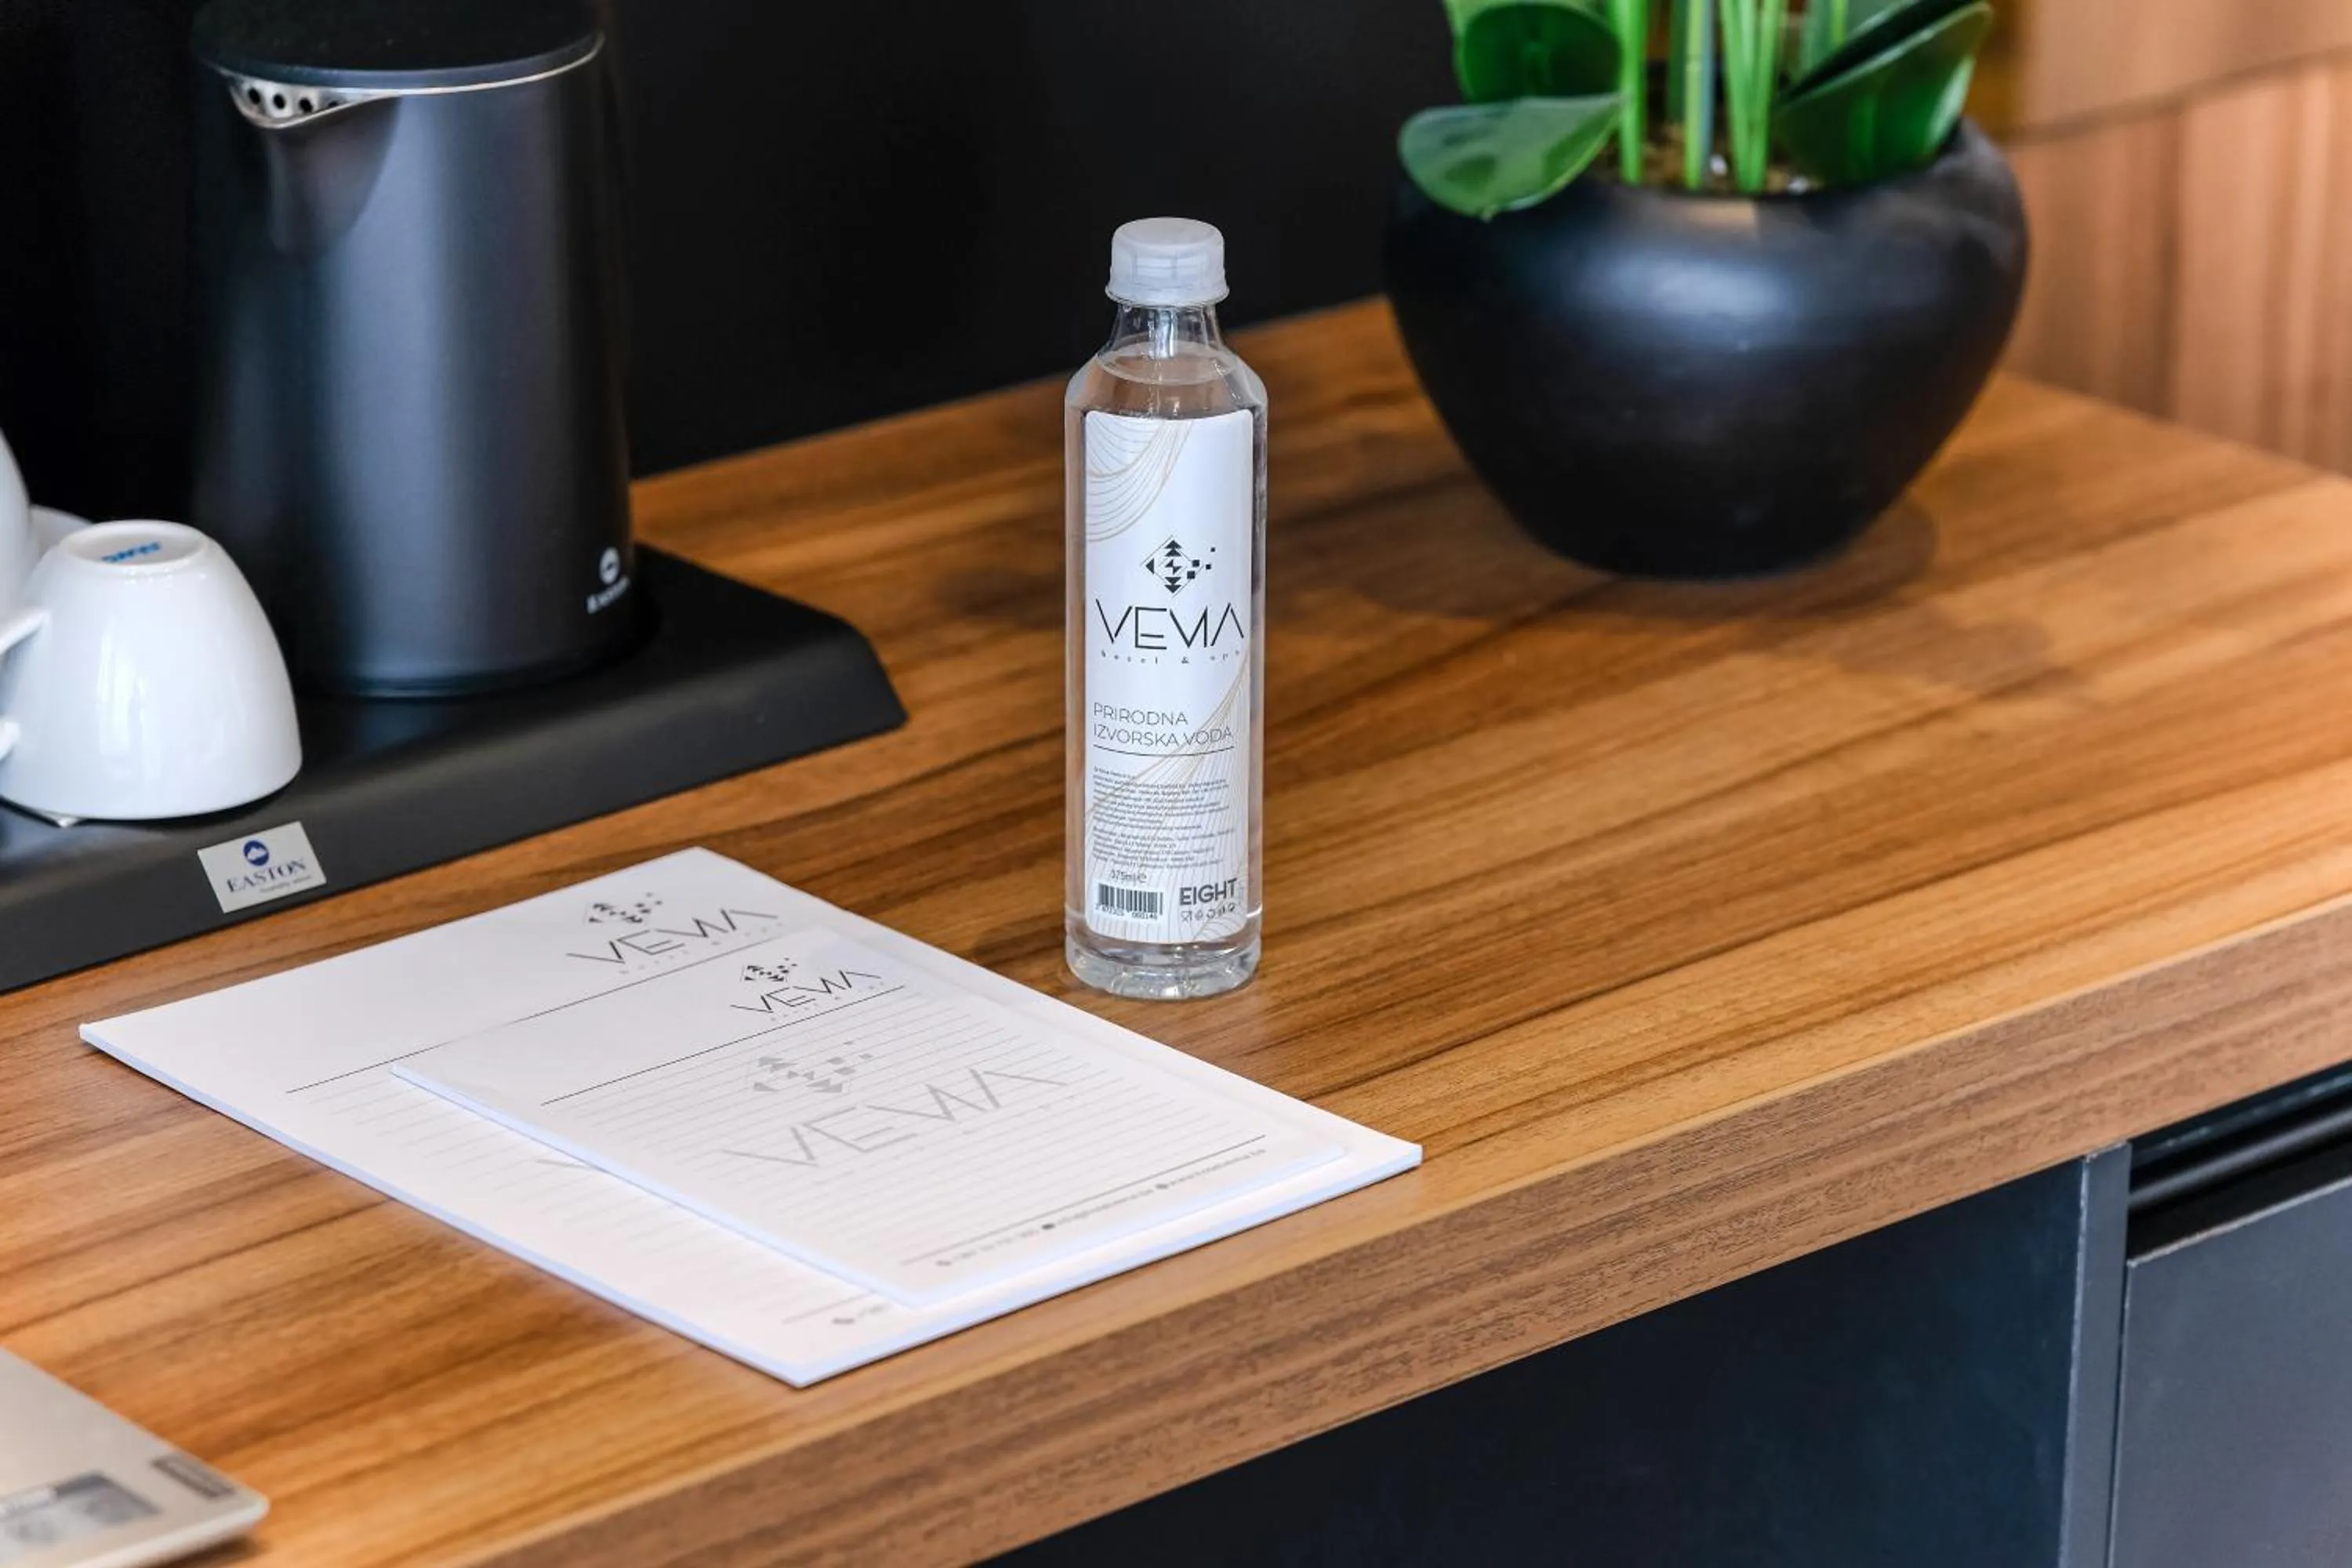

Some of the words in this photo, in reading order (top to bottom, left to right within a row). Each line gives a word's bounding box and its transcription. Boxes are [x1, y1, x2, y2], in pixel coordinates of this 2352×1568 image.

[1095, 598, 1245, 650] VEMA
[1093, 702, 1189, 726] PRIRODNA
[1093, 723, 1181, 747] IZVORSKA
[1183, 724, 1232, 746] VODA
[226, 858, 307, 893] EASTON
[1179, 877, 1238, 906] EIGHT
[564, 908, 779, 964] VEMA
[729, 969, 883, 1014] VEMA
